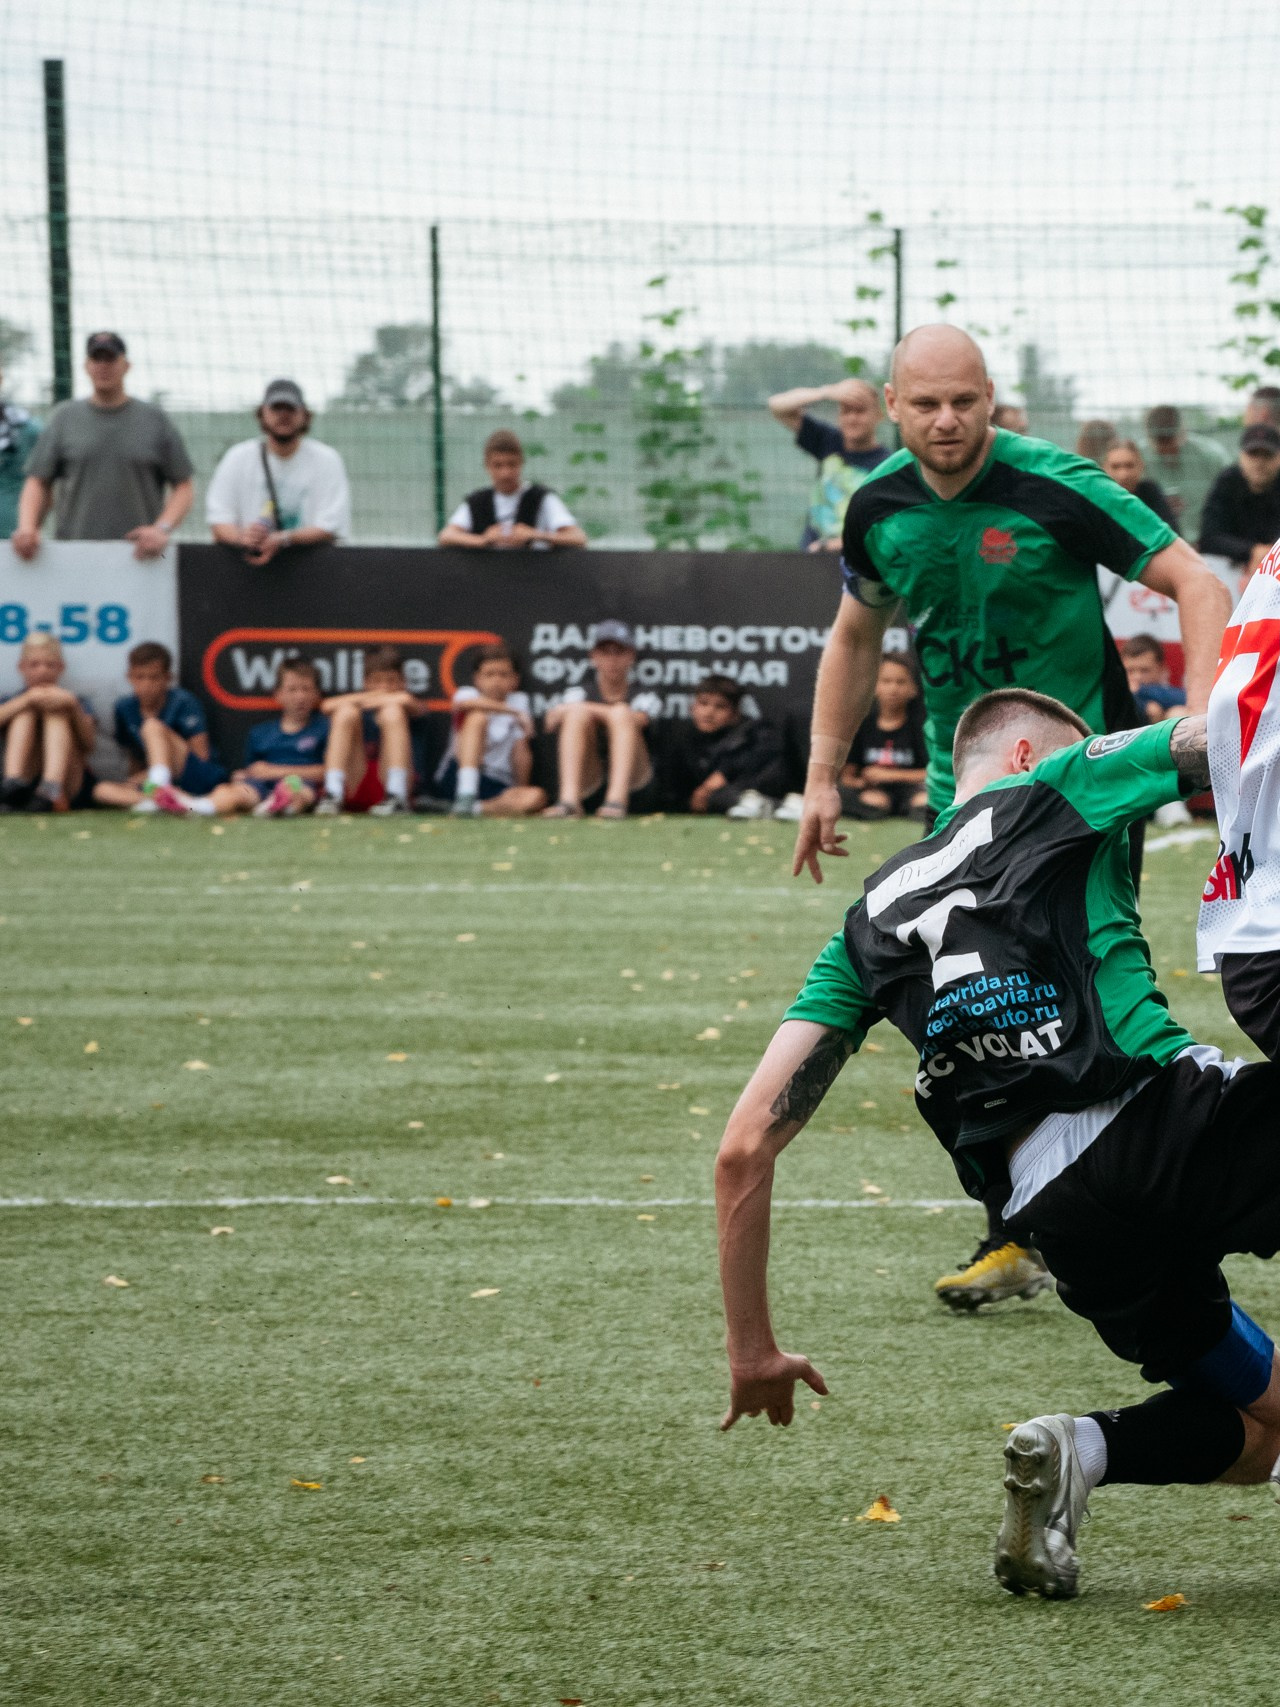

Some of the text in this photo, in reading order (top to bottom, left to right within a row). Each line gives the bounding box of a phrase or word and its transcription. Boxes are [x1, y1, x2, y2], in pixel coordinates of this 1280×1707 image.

[530, 623, 909, 655] ДАНЕВОСТОЧЯ
[231, 647, 430, 693] Wnlie
[531, 656, 789, 688] ФУОЛЬНАЯ
[915, 1019, 1063, 1099] FC VOLAT
